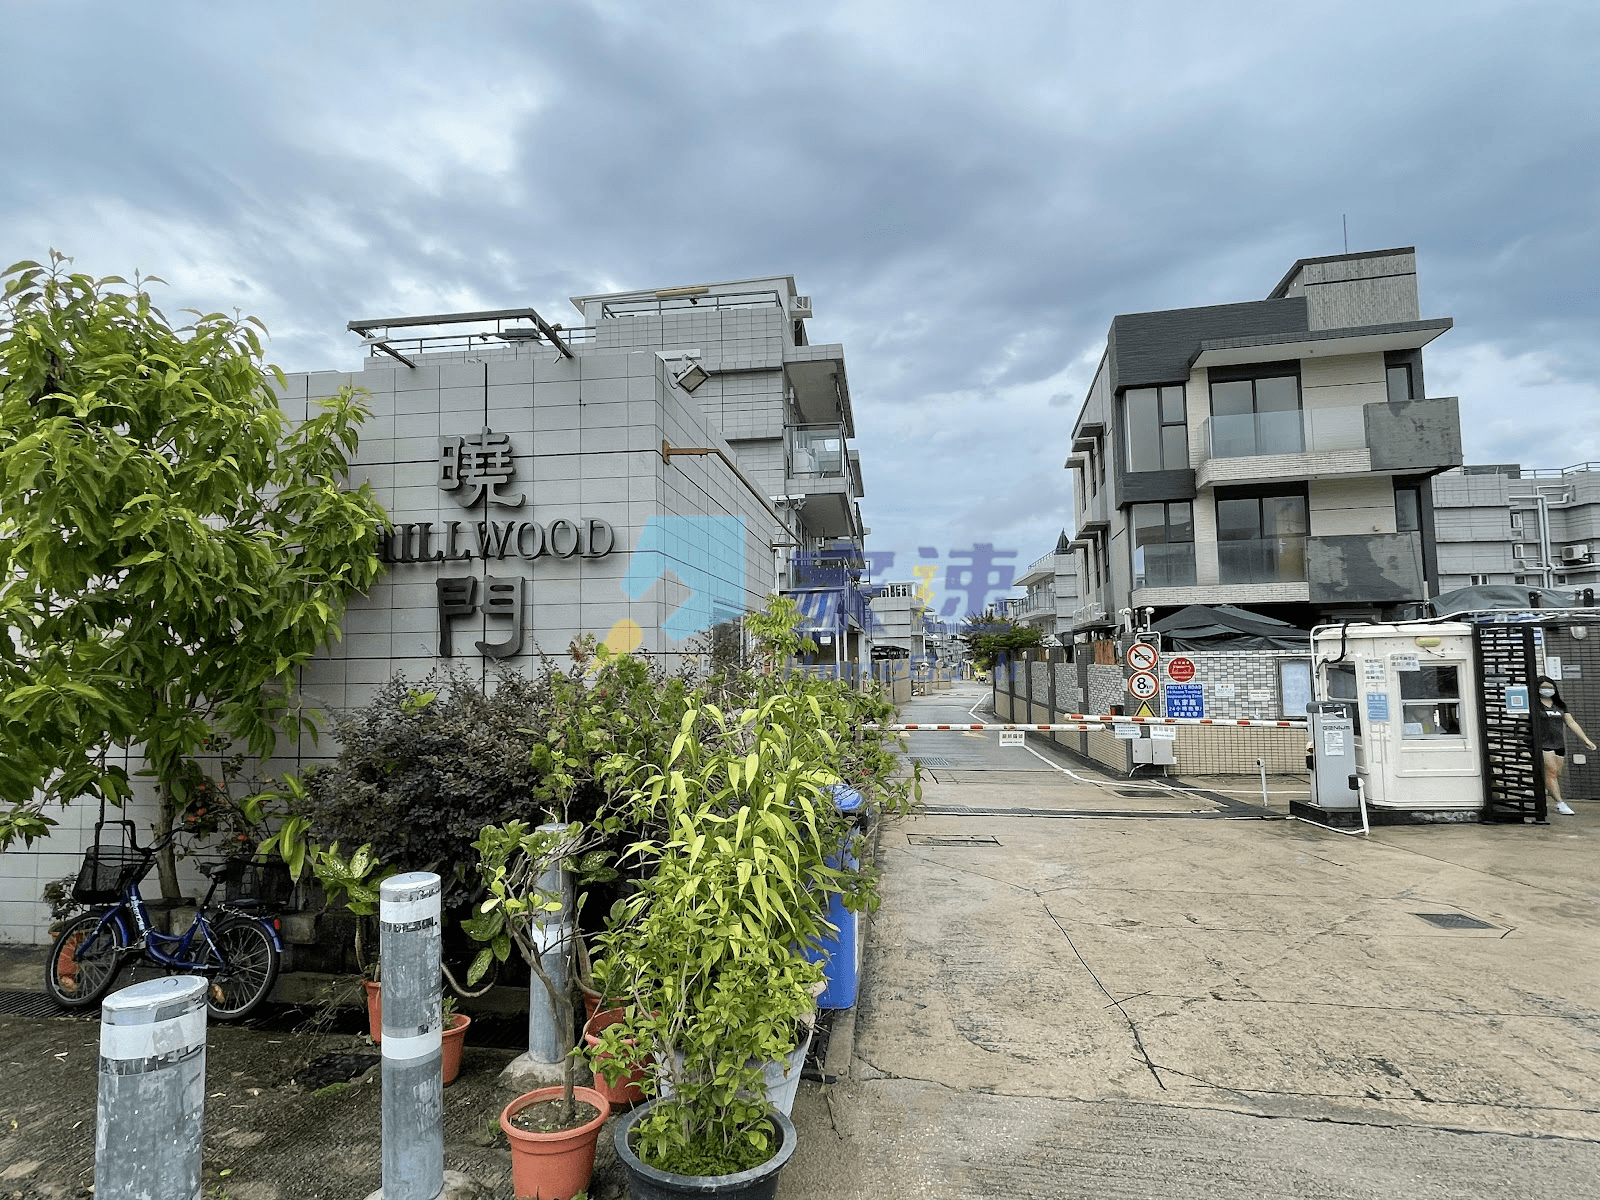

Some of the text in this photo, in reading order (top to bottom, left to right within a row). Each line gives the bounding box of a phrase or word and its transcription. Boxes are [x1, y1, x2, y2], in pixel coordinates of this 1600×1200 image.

[437, 426, 527, 508] 曉
[436, 574, 526, 658] 門
[1137, 677, 1147, 690] 8
